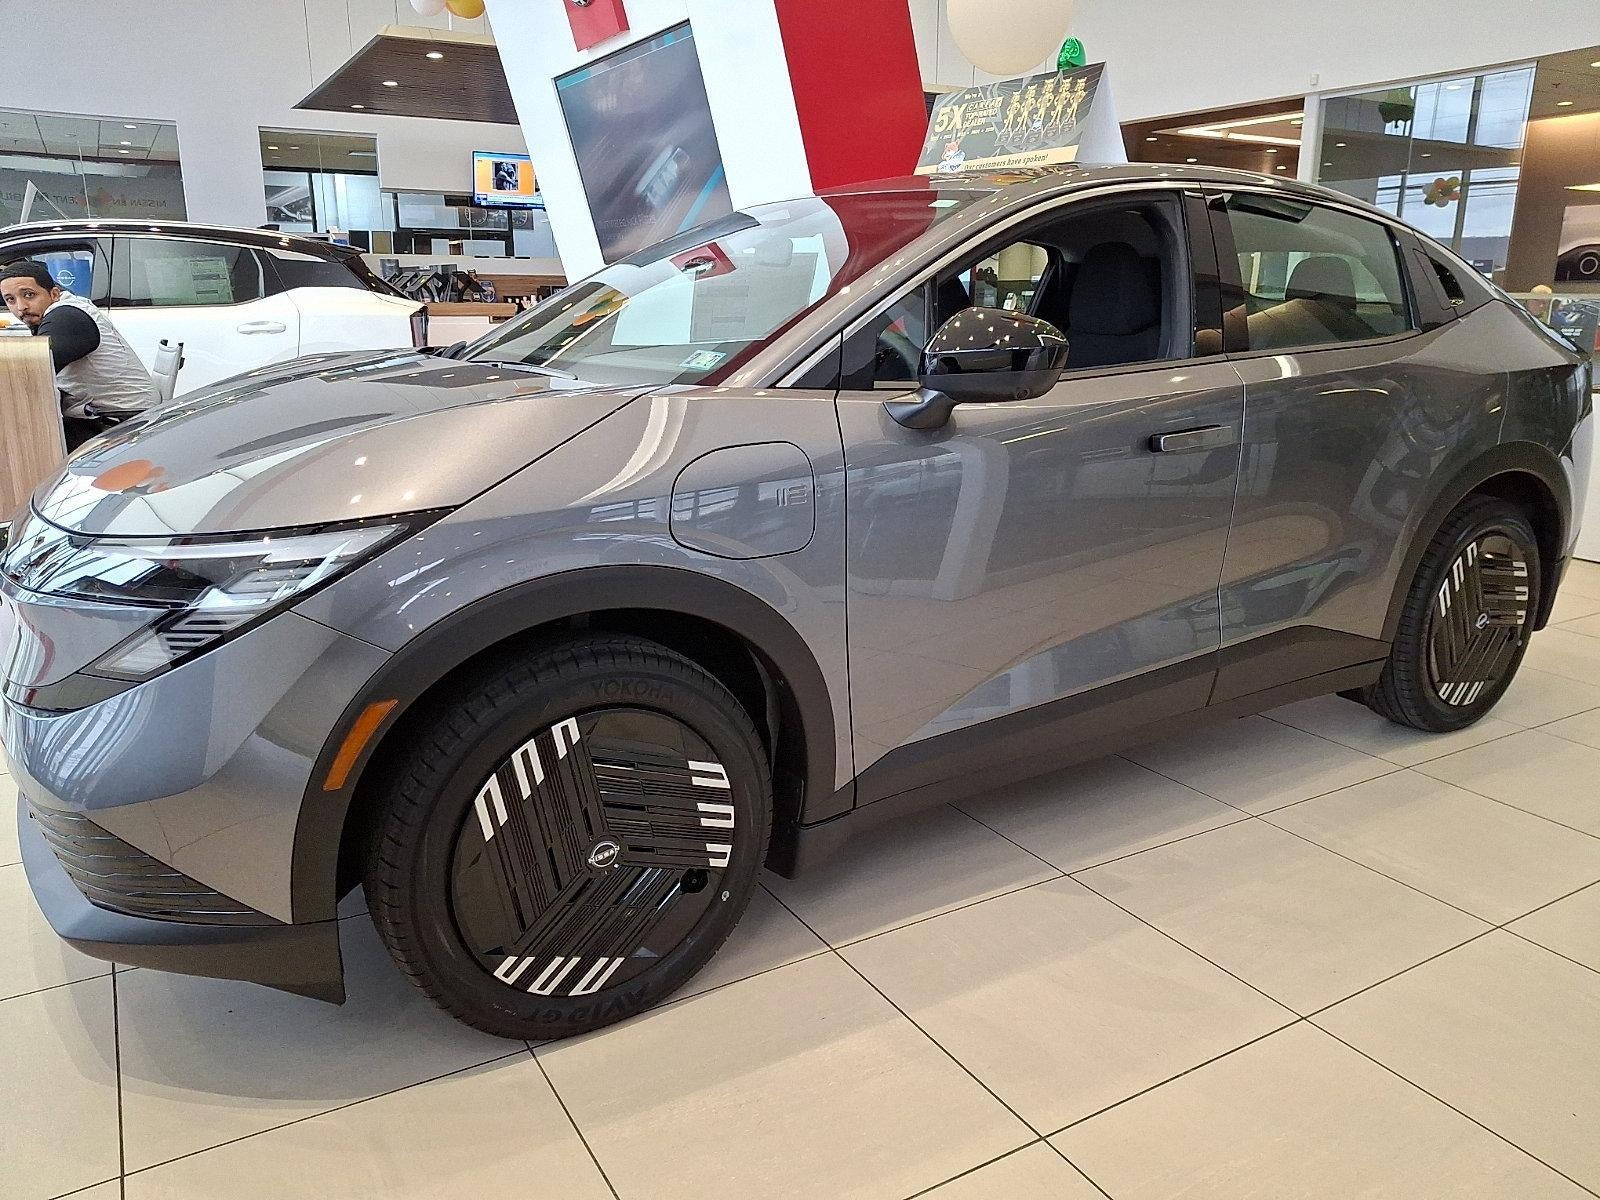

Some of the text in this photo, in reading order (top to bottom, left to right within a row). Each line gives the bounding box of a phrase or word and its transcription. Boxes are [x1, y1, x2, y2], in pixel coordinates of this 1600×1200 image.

[934, 103, 967, 133] 5X
[962, 118, 986, 129] DEALER
[976, 160, 1006, 169] customers
[1006, 158, 1022, 166] have
[1022, 153, 1049, 165] spoken!
[588, 846, 620, 864] NISSAN
